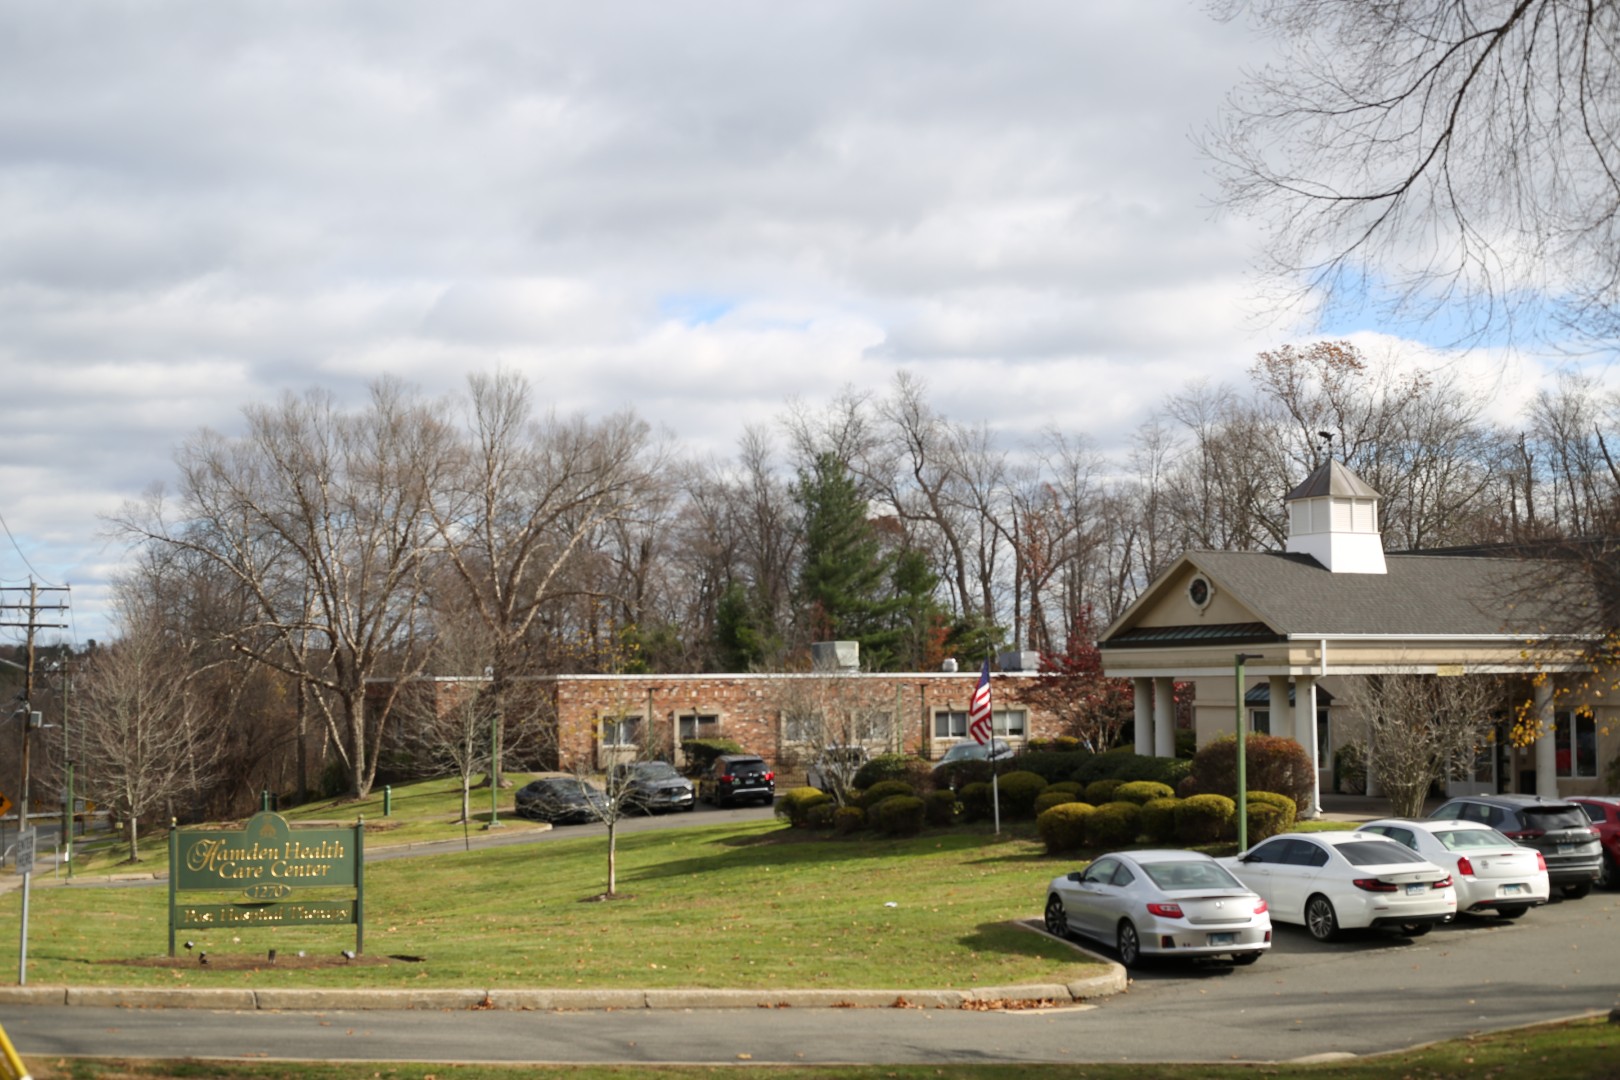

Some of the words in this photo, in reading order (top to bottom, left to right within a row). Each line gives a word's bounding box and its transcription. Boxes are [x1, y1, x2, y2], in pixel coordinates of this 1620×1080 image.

[186, 839, 279, 872] Hamden
[284, 840, 345, 860] Health
[218, 861, 264, 879] Care
[270, 860, 332, 878] Center
[254, 884, 284, 898] 1270
